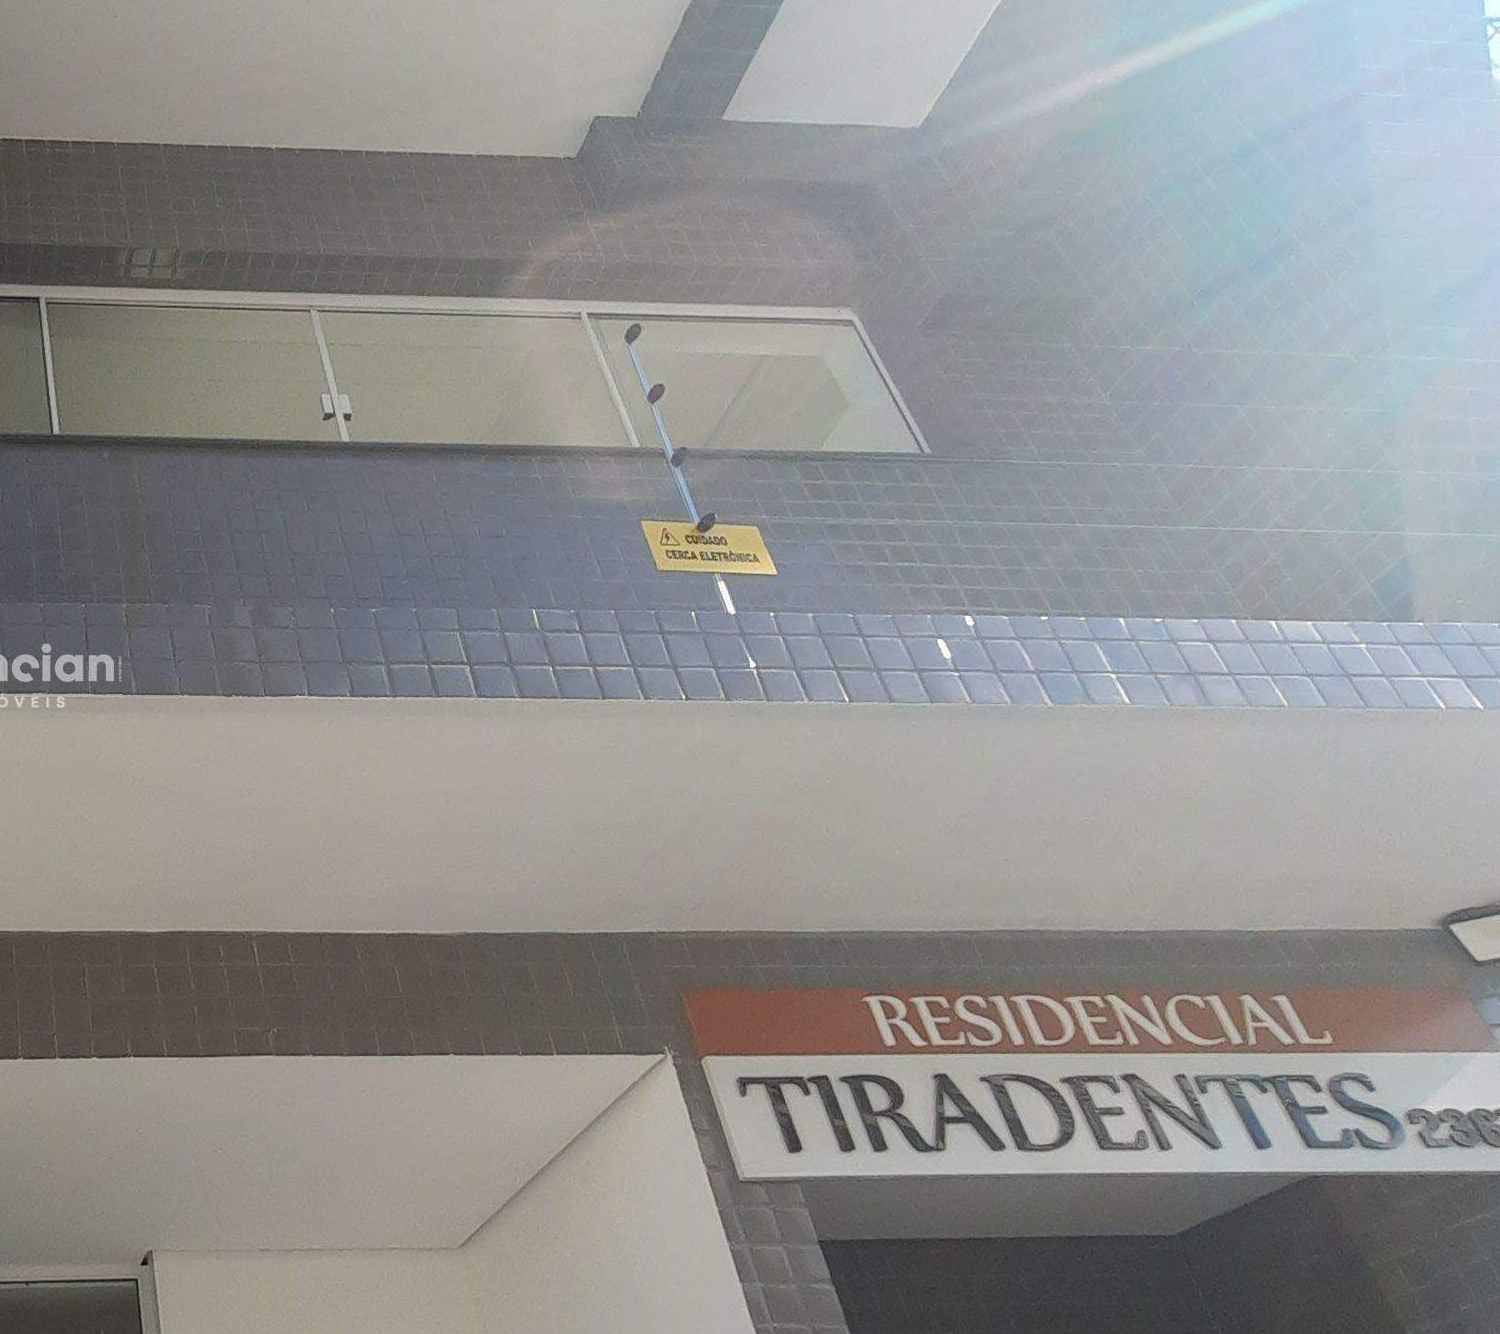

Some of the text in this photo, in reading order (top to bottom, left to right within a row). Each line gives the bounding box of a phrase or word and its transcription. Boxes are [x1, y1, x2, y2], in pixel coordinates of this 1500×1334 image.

[665, 549, 698, 561] CERCA
[861, 993, 1333, 1049] RESIDENCIAL
[737, 1072, 1406, 1155] TIRADENTES
